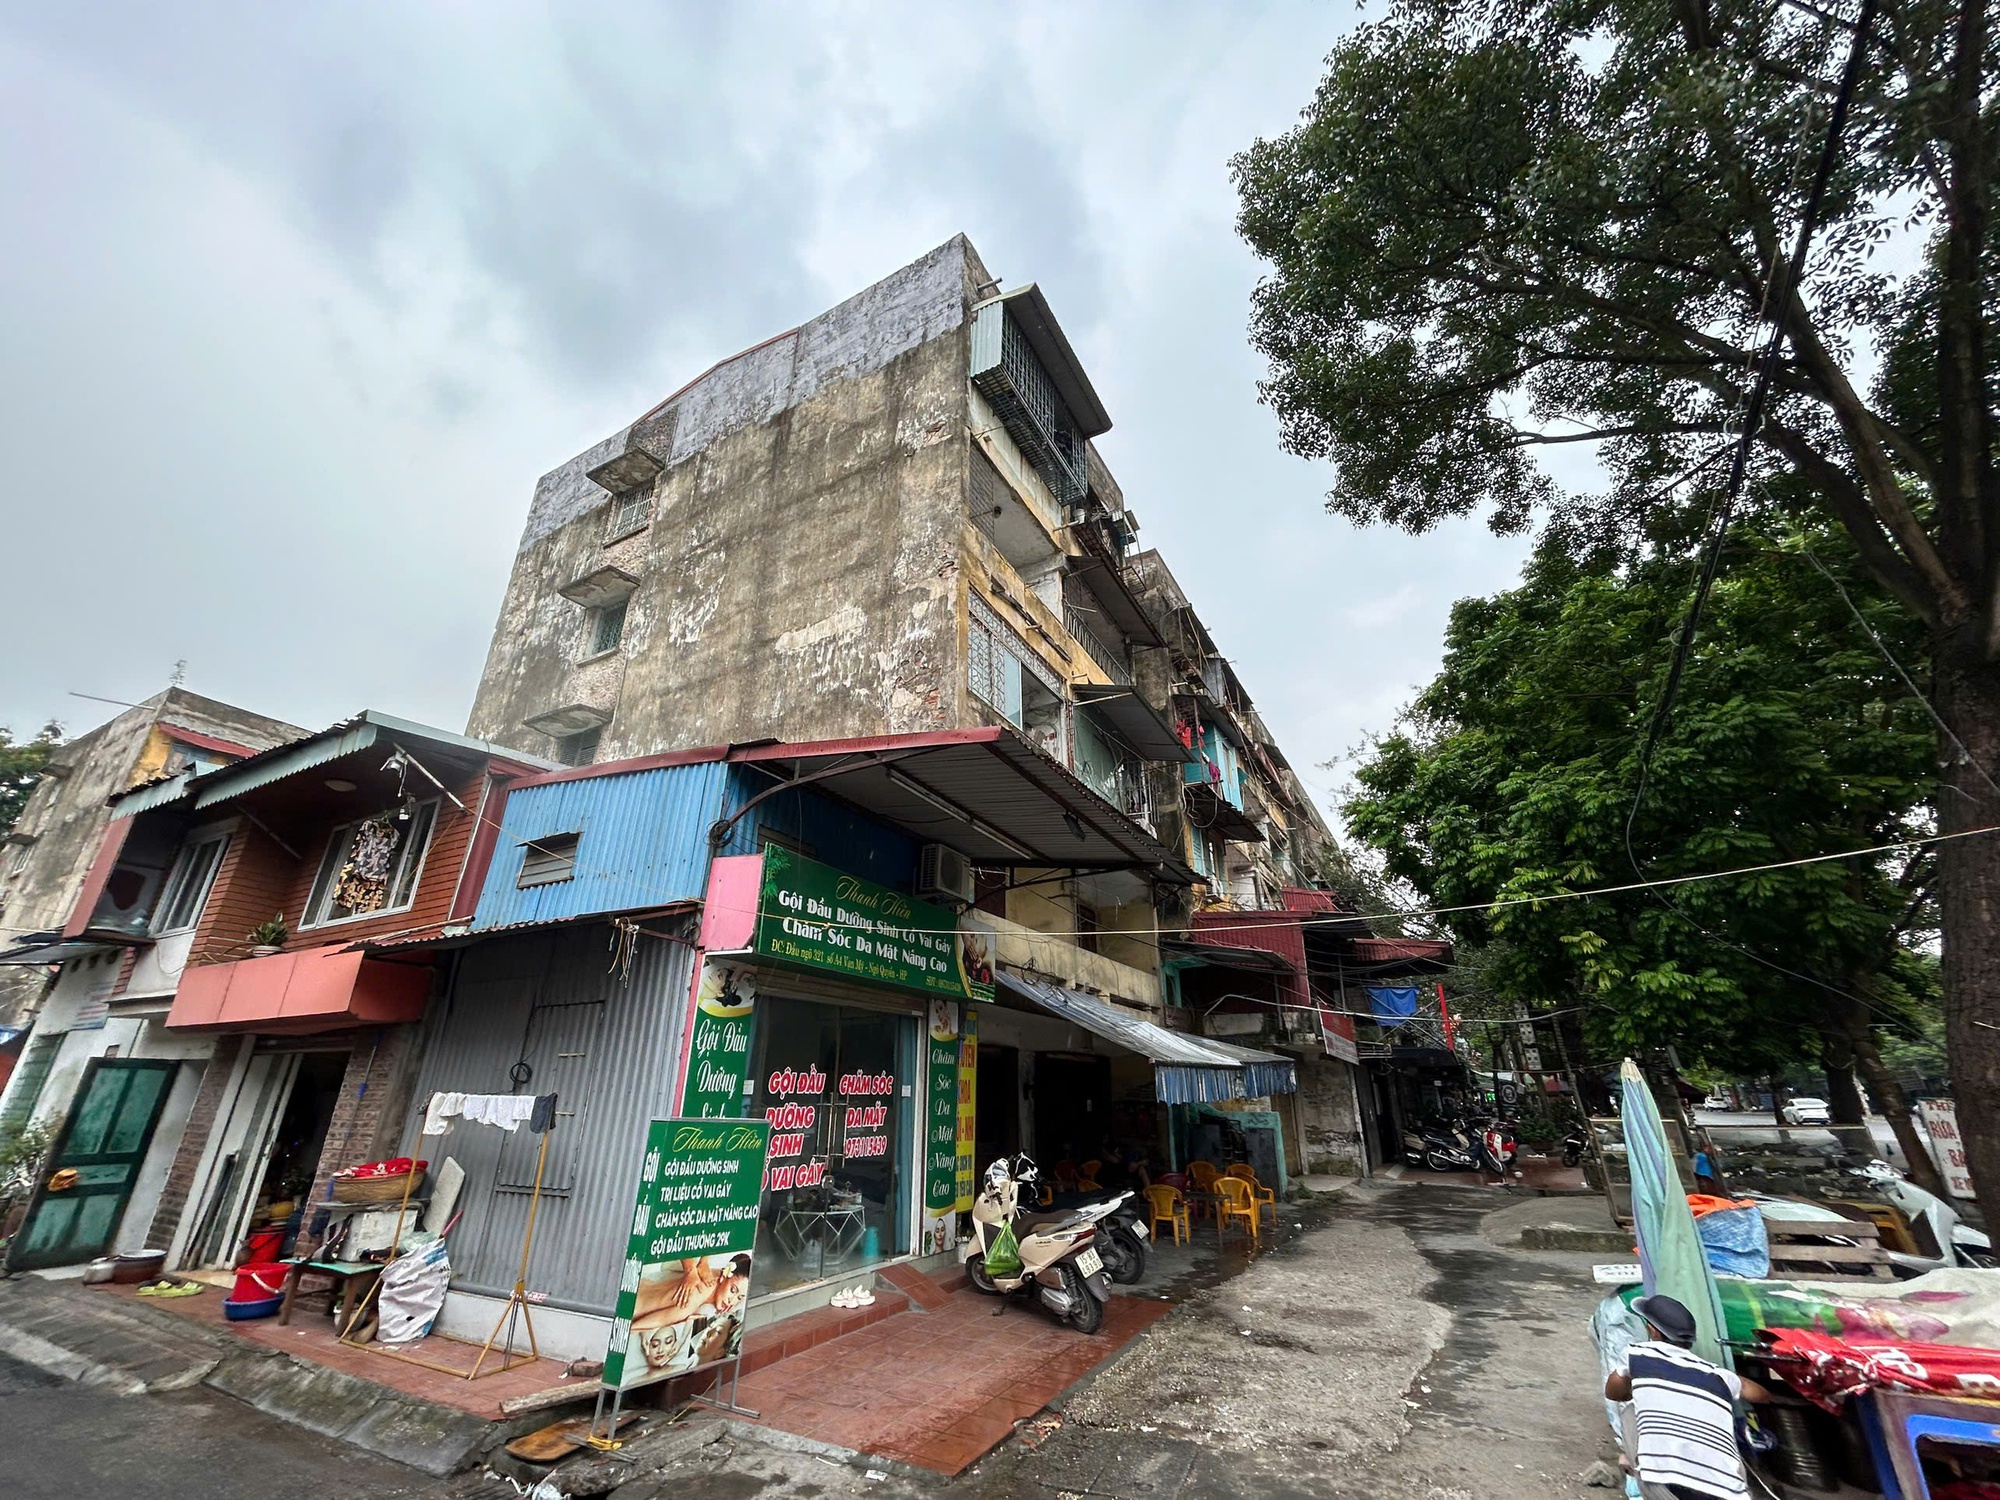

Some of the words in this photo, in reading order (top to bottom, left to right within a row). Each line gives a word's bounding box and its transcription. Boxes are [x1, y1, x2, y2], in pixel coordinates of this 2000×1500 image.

[836, 875, 879, 908] Thanh
[779, 890, 802, 913] Gội
[807, 897, 832, 919] Đầu
[877, 920, 898, 939] Sinh
[918, 932, 932, 948] Vai
[935, 938, 951, 956] Gáy
[783, 917, 822, 941] Chăm
[827, 928, 851, 948] Sóc
[856, 936, 872, 954] Da
[876, 941, 898, 963] Mặt
[902, 949, 926, 971] Nâng
[930, 957, 947, 973] Cao
[813, 949, 824, 962] 321
[696, 1019, 720, 1058] Gội
[768, 1066, 796, 1100] GỘI
[797, 1063, 826, 1094] ĐẦU
[839, 1069, 871, 1095] CHĂM
[871, 1070, 893, 1095] SÓC
[935, 1074, 951, 1091] Sóc
[765, 1102, 815, 1130] DƯỠNG
[846, 1107, 862, 1128] DA
[863, 1101, 887, 1131] MẶT
[935, 1098, 950, 1115] Da
[672, 1127, 725, 1152] Thanh
[726, 1127, 763, 1152] Hiền
[769, 1133, 804, 1158] SINH
[931, 1126, 953, 1144] Mặt
[643, 1146, 660, 1189] GỘI
[665, 1158, 680, 1180] GỘI
[722, 1160, 739, 1174] SINH
[771, 1165, 796, 1191] VAI
[796, 1157, 825, 1188] GÁY
[928, 1152, 955, 1171] Nâng
[660, 1187, 672, 1205] TRỊ
[673, 1182, 690, 1204] LIỆU
[691, 1177, 703, 1200] CỔ
[704, 1183, 715, 1199] VAI
[716, 1179, 732, 1198] GÁY
[932, 1180, 949, 1197] Cao
[655, 1209, 680, 1228] CHĂM
[680, 1206, 696, 1226] SÓC
[696, 1209, 706, 1224] DA
[707, 1204, 723, 1226] MẶT
[743, 1204, 758, 1220] CAO
[651, 1234, 666, 1259] GỘI
[716, 1231, 731, 1247] 29K
[609, 1316, 632, 1355] SINH
